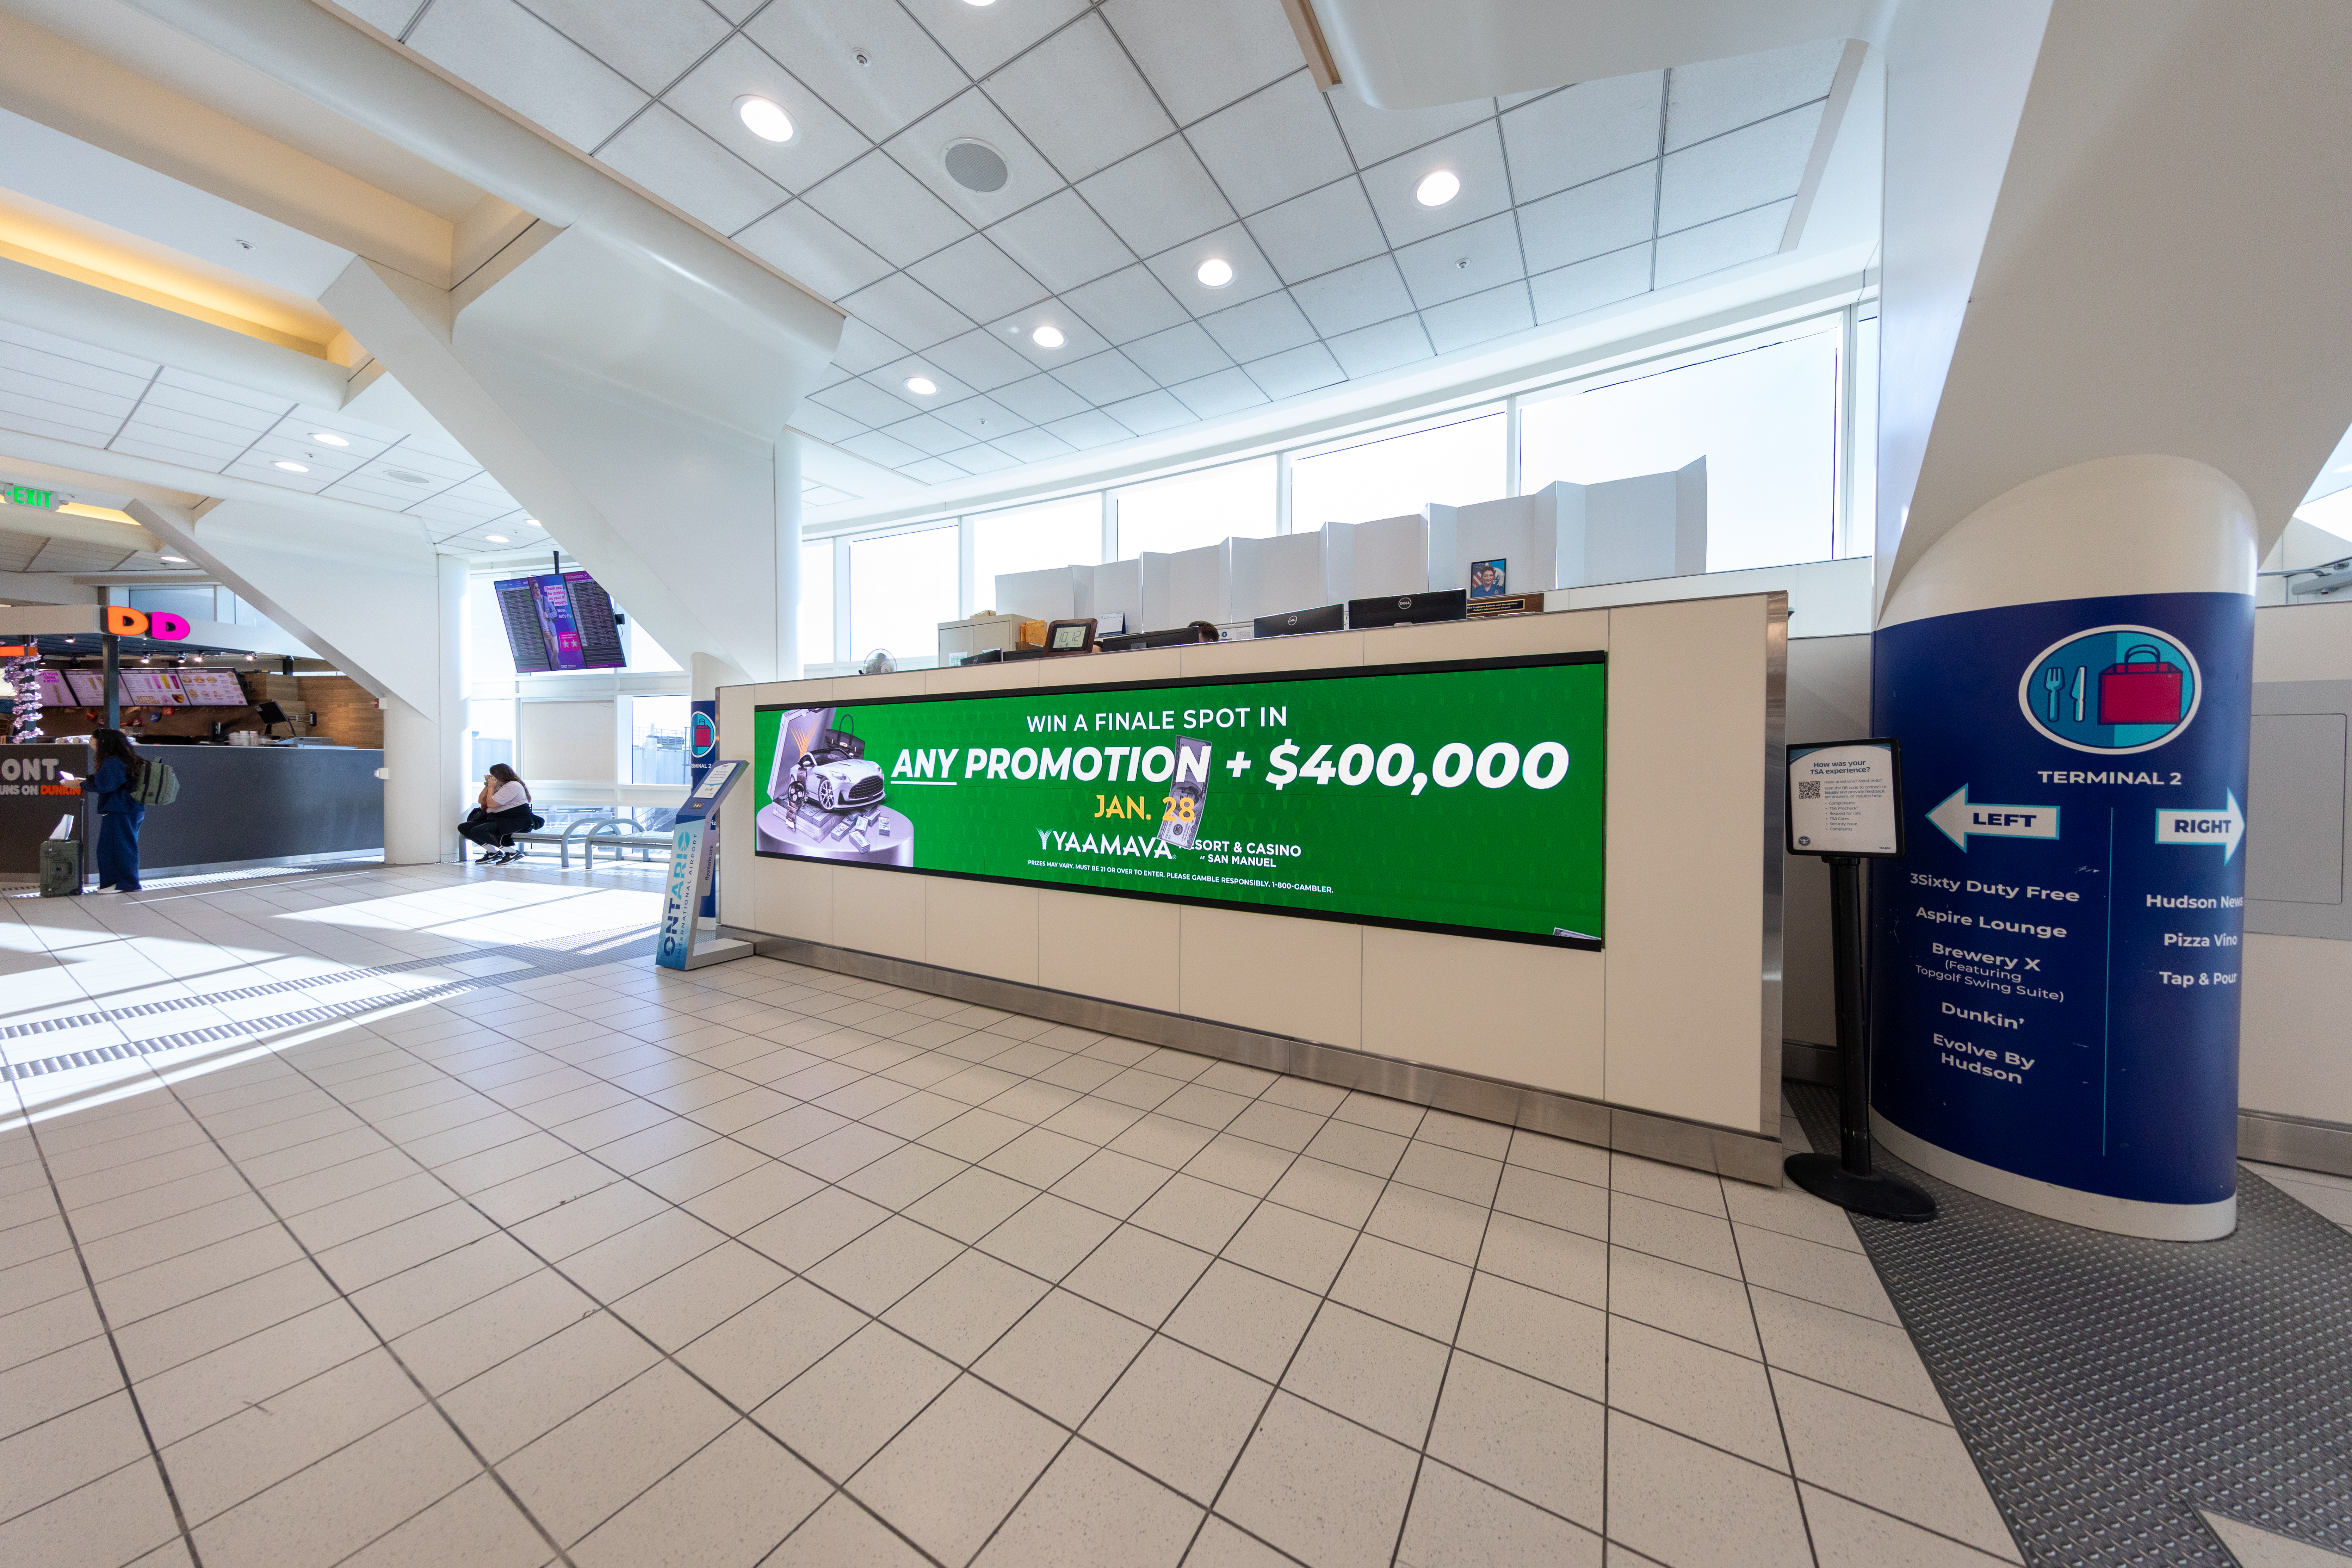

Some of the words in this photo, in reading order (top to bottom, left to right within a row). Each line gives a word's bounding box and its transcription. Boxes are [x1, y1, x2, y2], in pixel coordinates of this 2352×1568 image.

[14, 486, 51, 508] EXIT
[1027, 715, 1066, 732] WIN
[1074, 714, 1088, 731] A
[1096, 711, 1174, 731] FINALE
[1184, 708, 1250, 728] SPOT
[1261, 706, 1286, 726] IN
[1, 758, 59, 781] ONT
[891, 749, 959, 778] ANY
[965, 745, 1212, 783] PROMOTION
[1226, 752, 1251, 777] +
[1265, 739, 1569, 795] $400,000
[2038, 771, 2164, 785] TERMINAL
[2170, 773, 2181, 785] 2
[21, 785, 39, 795] ON
[1095, 795, 1151, 820] JAN.
[1163, 797, 1194, 822] 28
[1973, 813, 2036, 827] LEFT
[2174, 819, 2231, 833] RIGHT
[1179, 839, 1230, 852] SORT
[1234, 842, 1242, 853] &
[1247, 843, 1301, 857] CASINO
[705, 845, 713, 880] flyontario.com
[1208, 854, 1228, 863] SAN
[1232, 856, 1276, 867] MANUEL
[664, 831, 690, 956] ONTARIO
[677, 881, 691, 958] INTERNATIONAL
[689, 834, 697, 875] AIRPORT
[1221, 877, 1270, 887] RESPONSIBLY.
[1272, 882, 1333, 893] 1-800-GAMBLER.
[1911, 873, 1961, 892] 3Sixty
[1967, 880, 2019, 898] Duty
[2027, 886, 2079, 901] Free
[2147, 895, 2217, 909] Hudson
[2221, 897, 2243, 908] News
[1916, 907, 1972, 925] Aspire
[1980, 917, 2067, 938] Lounge
[2165, 933, 2210, 947] Pizza
[2214, 933, 2238, 946] Vino
[1932, 942, 2018, 969] Brewery
[2025, 958, 2040, 971] X
[1945, 960, 2021, 983] (Featuring
[2159, 972, 2194, 987] Tap
[2199, 973, 2209, 985] &
[2214, 973, 2237, 984] Pour
[1915, 965, 1961, 983] Topgolf
[1964, 976, 2011, 994] Swing
[2016, 986, 2064, 1003] Suite)
[1934, 1033, 1997, 1060] Evolve
[2005, 1052, 2035, 1070] By
[1942, 1052, 2022, 1084] Hudson
